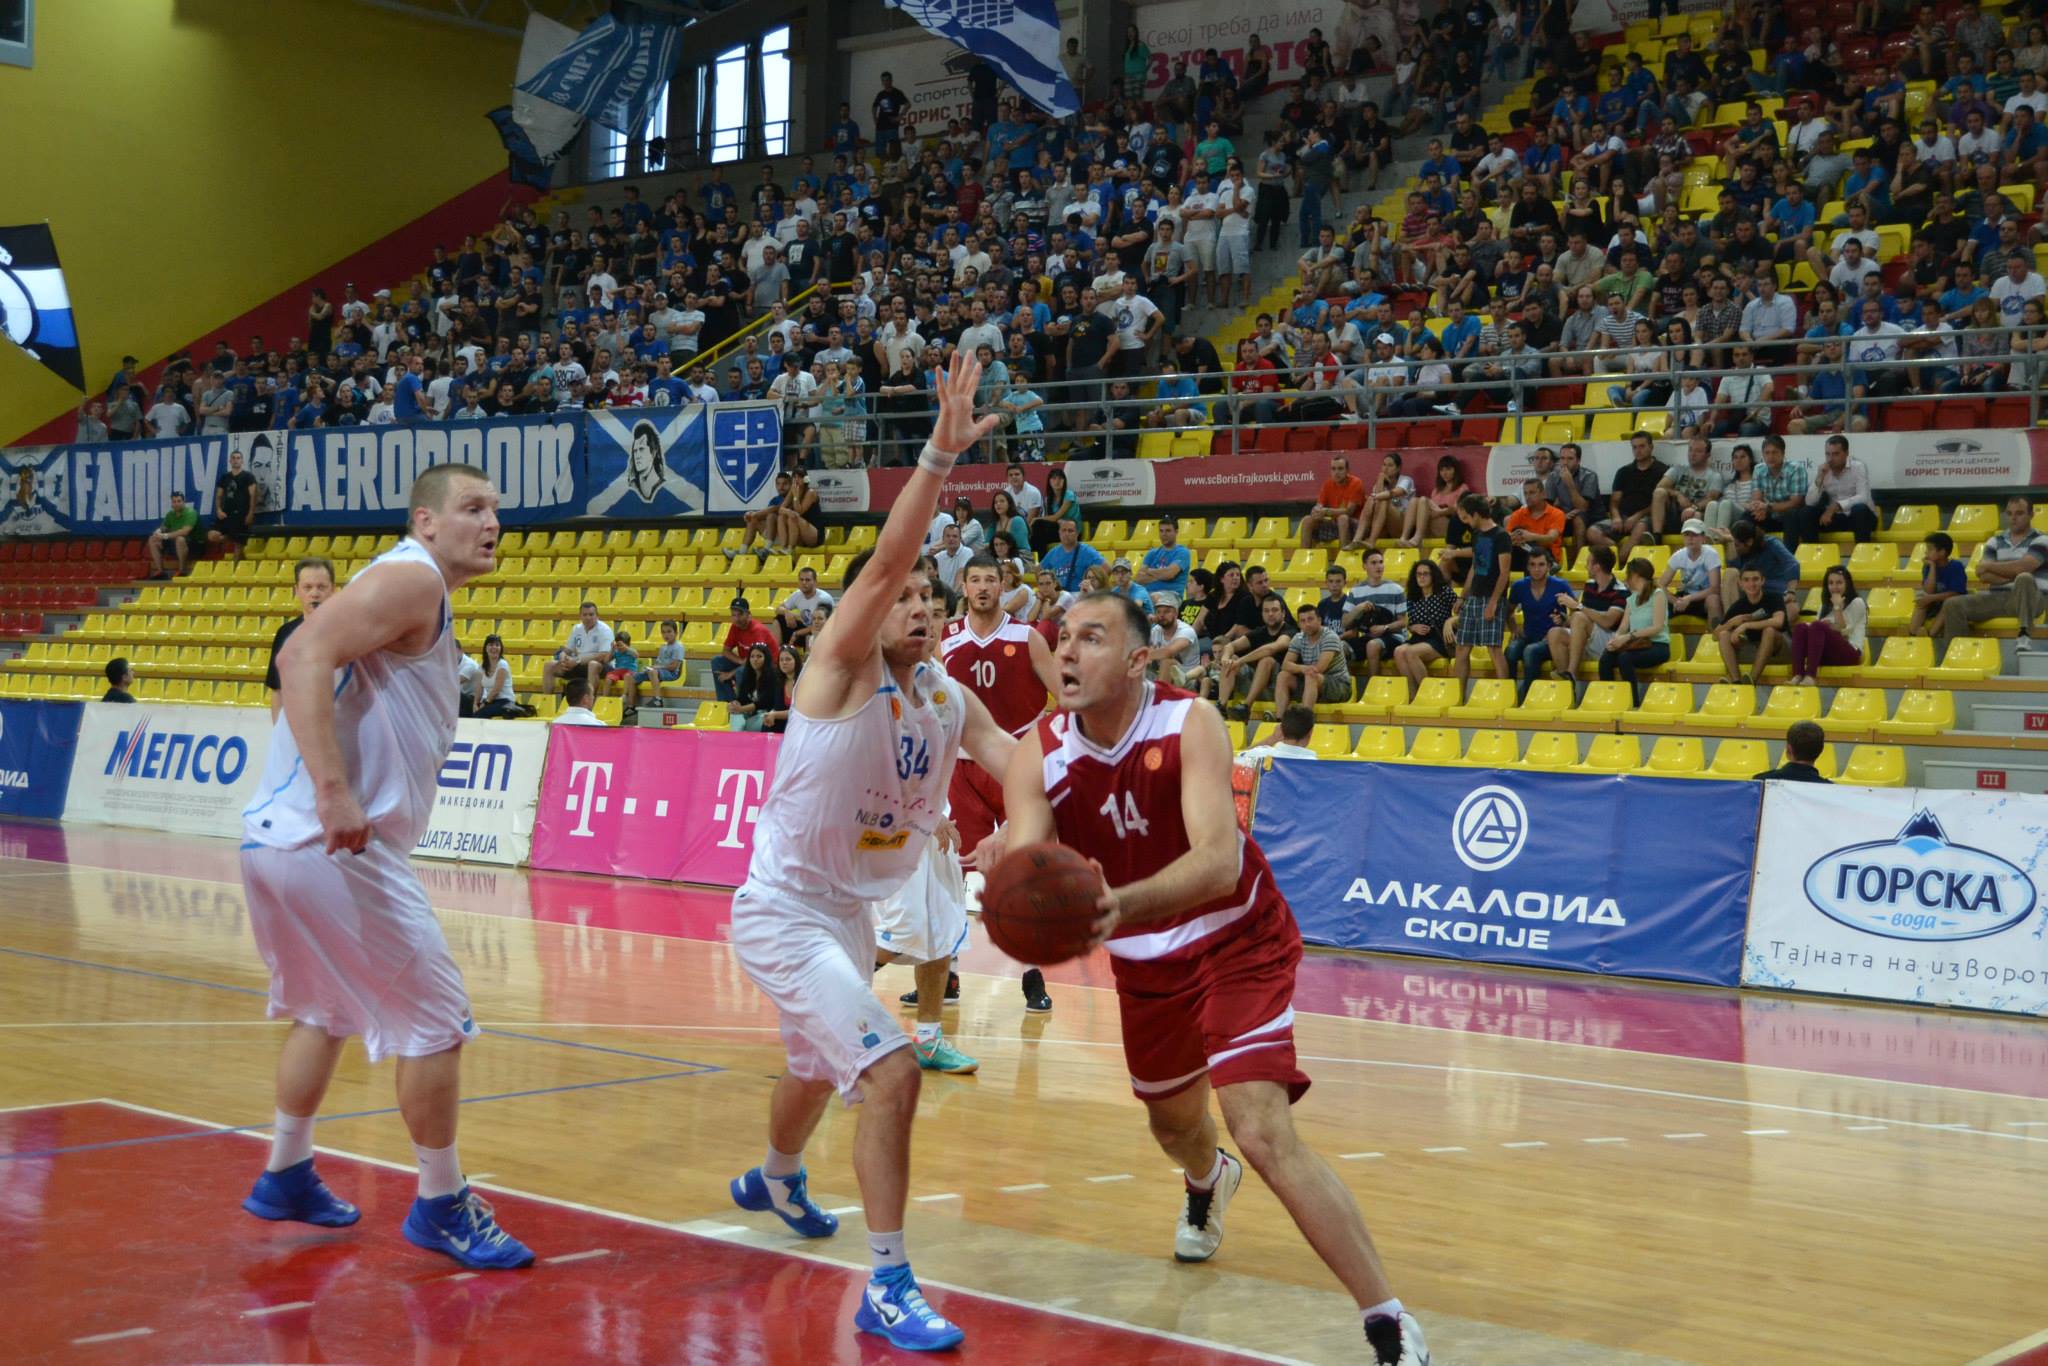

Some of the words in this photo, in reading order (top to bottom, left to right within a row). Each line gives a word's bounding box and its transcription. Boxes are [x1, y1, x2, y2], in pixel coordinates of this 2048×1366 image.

[1146, 26, 1192, 48] Секој
[1199, 15, 1250, 43] треба
[1257, 14, 1280, 34] да
[1286, 8, 1322, 26] има
[1183, 470, 1315, 487] www.scBorisTrajkovski.gov.mk
[1904, 467, 1940, 477] БОРИС
[969, 659, 997, 689] 10
[2031, 716, 2046, 728] IV
[896, 735, 930, 781] 34
[1982, 773, 2001, 786] III
[439, 795, 505, 810] МАКЕДОНИЈА
[1099, 790, 1150, 840] 14
[416, 829, 451, 849] ШАТА
[453, 832, 498, 855] ЗЕМЈА
[1342, 877, 1627, 927] АЛКАЛОИД
[1835, 863, 2002, 914] ГОРСКА
[1404, 917, 1551, 951] СКОПЈЕ
[1891, 912, 1937, 931] вода
[1769, 940, 1874, 968] Тајната
[1887, 957, 1917, 973] на
